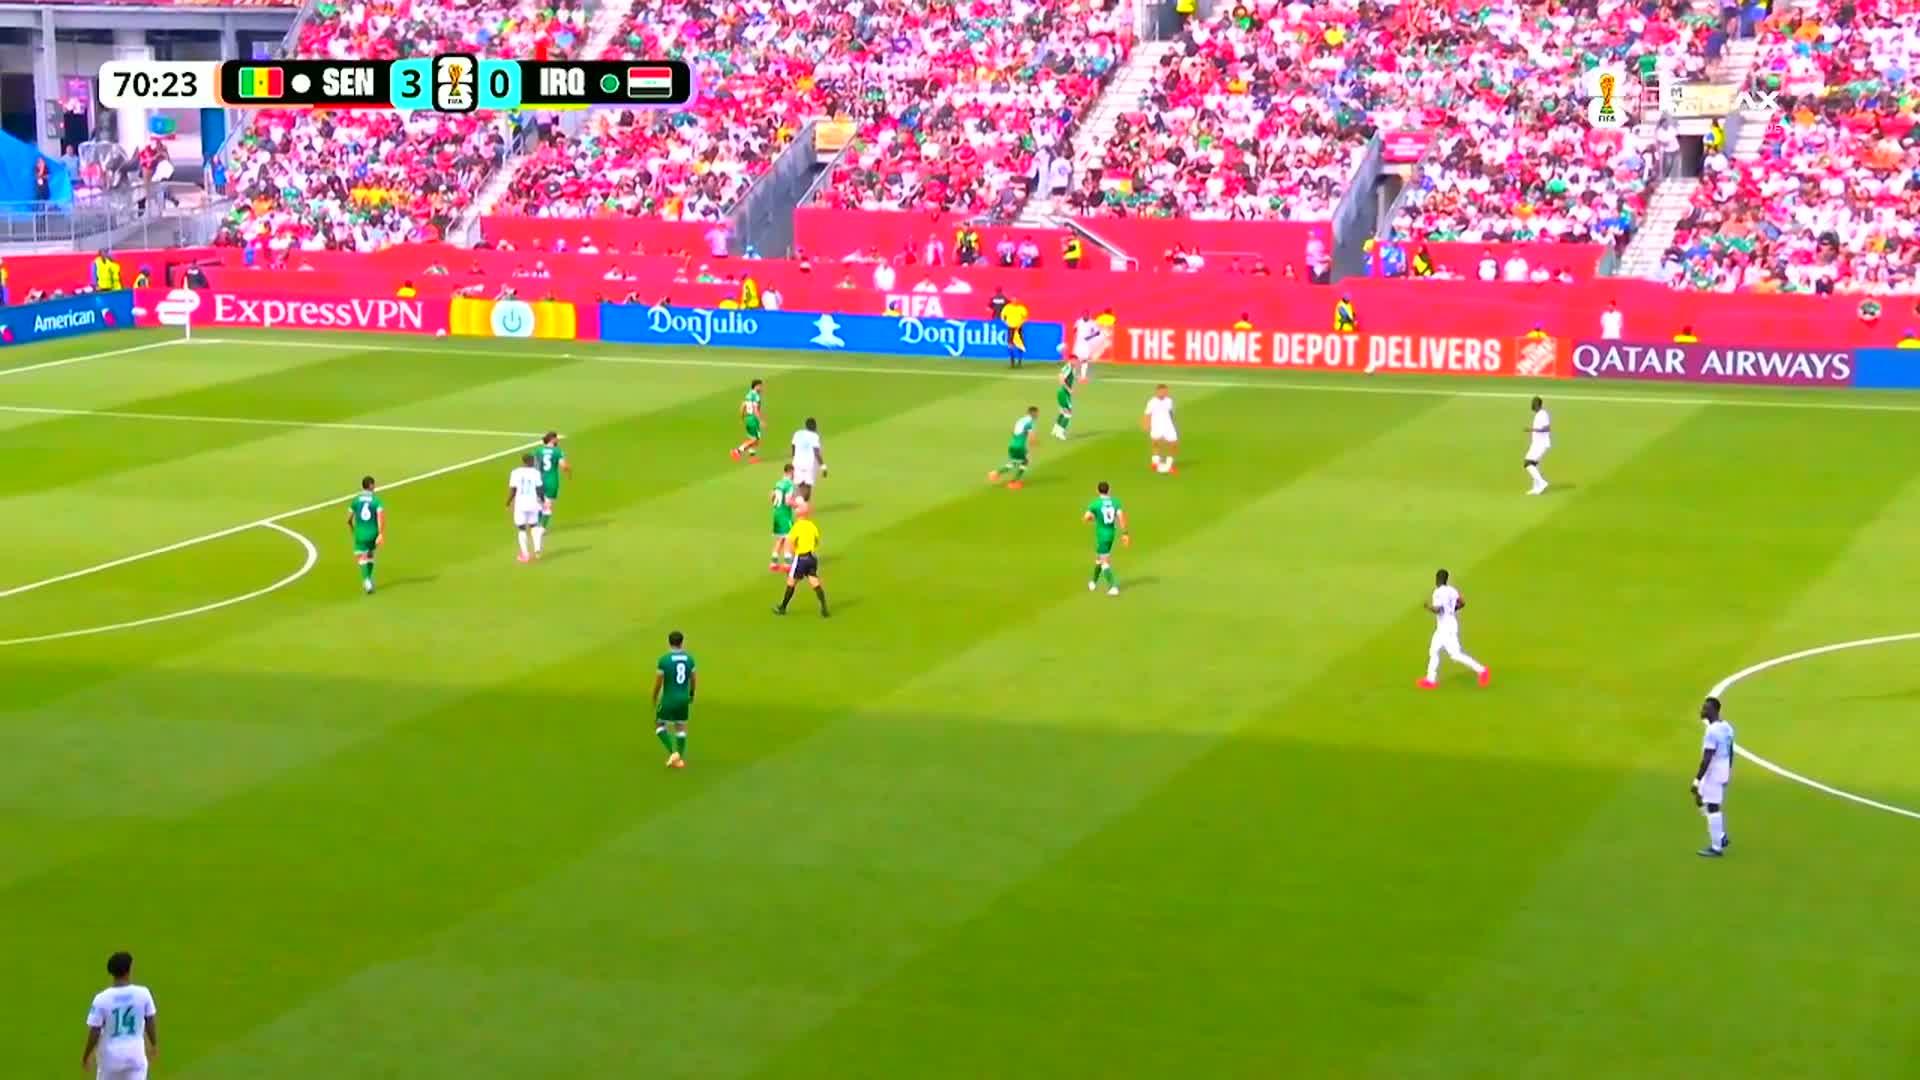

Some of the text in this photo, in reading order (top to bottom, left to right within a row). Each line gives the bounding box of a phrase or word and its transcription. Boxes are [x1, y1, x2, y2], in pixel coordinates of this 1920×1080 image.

[33, 308, 95, 333] American
[213, 294, 424, 328] ExpressVPN
[1128, 328, 1176, 361] THE
[1185, 331, 1263, 363] HOME
[1272, 332, 1360, 367] DEPOT
[1369, 335, 1501, 371] DELIVERS
[1571, 344, 1686, 376] QATAR
[1699, 349, 1851, 381] AIRWAYS
[360, 502, 372, 521] 6
[675, 662, 686, 685] 8
[110, 1004, 137, 1038] 14
